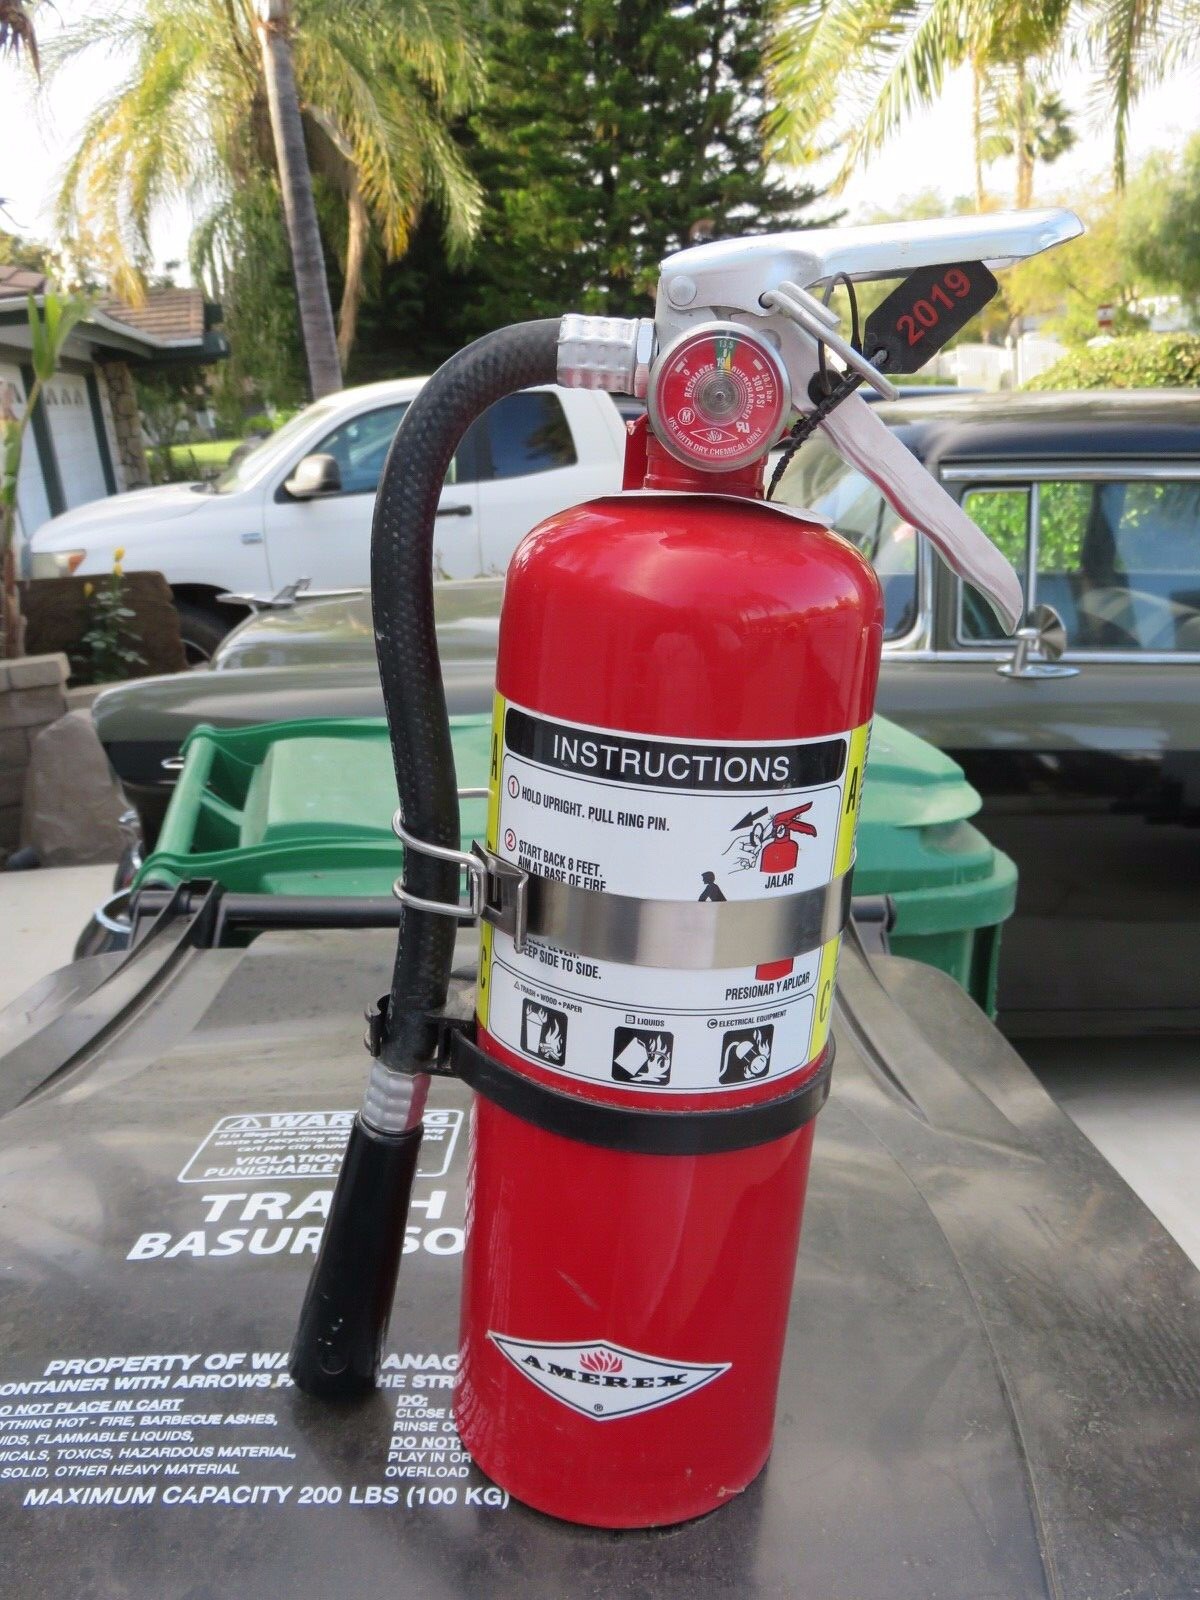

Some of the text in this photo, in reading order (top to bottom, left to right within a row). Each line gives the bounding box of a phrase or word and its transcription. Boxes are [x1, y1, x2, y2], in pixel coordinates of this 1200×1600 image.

[896, 268, 971, 346] 2019
[684, 363, 714, 398] RECHARGE
[731, 366, 754, 420] OVERCHARGED
[756, 394, 765, 408] PSI
[668, 416, 762, 456] USE WITH DRY CHEMICAL ONLY
[491, 733, 498, 781] A
[553, 734, 789, 783] INSTRUCTIONS
[846, 767, 858, 814] A
[522, 786, 541, 806] HOLD
[543, 793, 585, 819] UPRIGHT.
[589, 806, 614, 824] PULL
[617, 812, 644, 829] RING
[647, 816, 670, 831] PIN.
[518, 839, 542, 860] START
[543, 850, 566, 869] BACK
[568, 858, 574, 871] 8
[576, 859, 602, 877] FEET.
[518, 855, 531, 871] AIM
[533, 861, 543, 876] AT
[544, 865, 567, 882] BASE
[568, 873, 582, 886] OF
[765, 873, 793, 889] JALAR
[540, 950, 559, 968] SIDE
[561, 957, 573, 972] TO
[576, 961, 601, 979] SIDE.
[725, 971, 810, 1001] PRESIONAR Y APLICAR
[520, 984, 536, 998] TRASH
[540, 993, 557, 1006] WOOD
[562, 1002, 583, 1013] PAPER
[820, 979, 831, 1023] C
[637, 1017, 665, 1027] LIQUIDS
[719, 1017, 755, 1028] ELECTRICAL
[757, 1009, 787, 1023] EQUIPMENT
[203, 1163, 336, 1178] PUNISHABLE
[126, 1227, 324, 1261] BASUR
[43, 1354, 202, 1377] PROPERTY
[204, 1353, 247, 1371] OF
[521, 1354, 689, 1388] AMEREX
[0, 1378, 107, 1396] ONTAINER
[114, 1375, 168, 1390] WITH
[172, 1374, 271, 1389] ARROWS
[15, 1403, 53, 1415] NOT
[54, 1400, 111, 1413] PLACE
[114, 1400, 134, 1412] IN
[138, 1398, 184, 1412] CART
[395, 1408, 445, 1419] CLOSE
[55, 1417, 88, 1429] HOT
[99, 1416, 135, 1429] FIRE,
[139, 1414, 222, 1426] BARBECUE
[223, 1413, 278, 1427] ASHES,
[393, 1421, 438, 1432] RINSE
[35, 1431, 129, 1444] FLAMMABLE
[130, 1430, 195, 1443] LIQUIDS,
[389, 1437, 416, 1449] DO
[57, 1448, 113, 1461] TOXICS,
[118, 1447, 214, 1459] HAZARDOUS
[217, 1446, 296, 1459] MATERIAL,
[387, 1452, 427, 1463] PLAY
[430, 1452, 445, 1463] IN
[0, 1463, 240, 1479] SOLID, OTHER HEAVY MATERIAL
[385, 1465, 470, 1478] OVERLOAD
[23, 1485, 510, 1509] MAXIMUM CAPACITY 200 LBS (100 KG)
